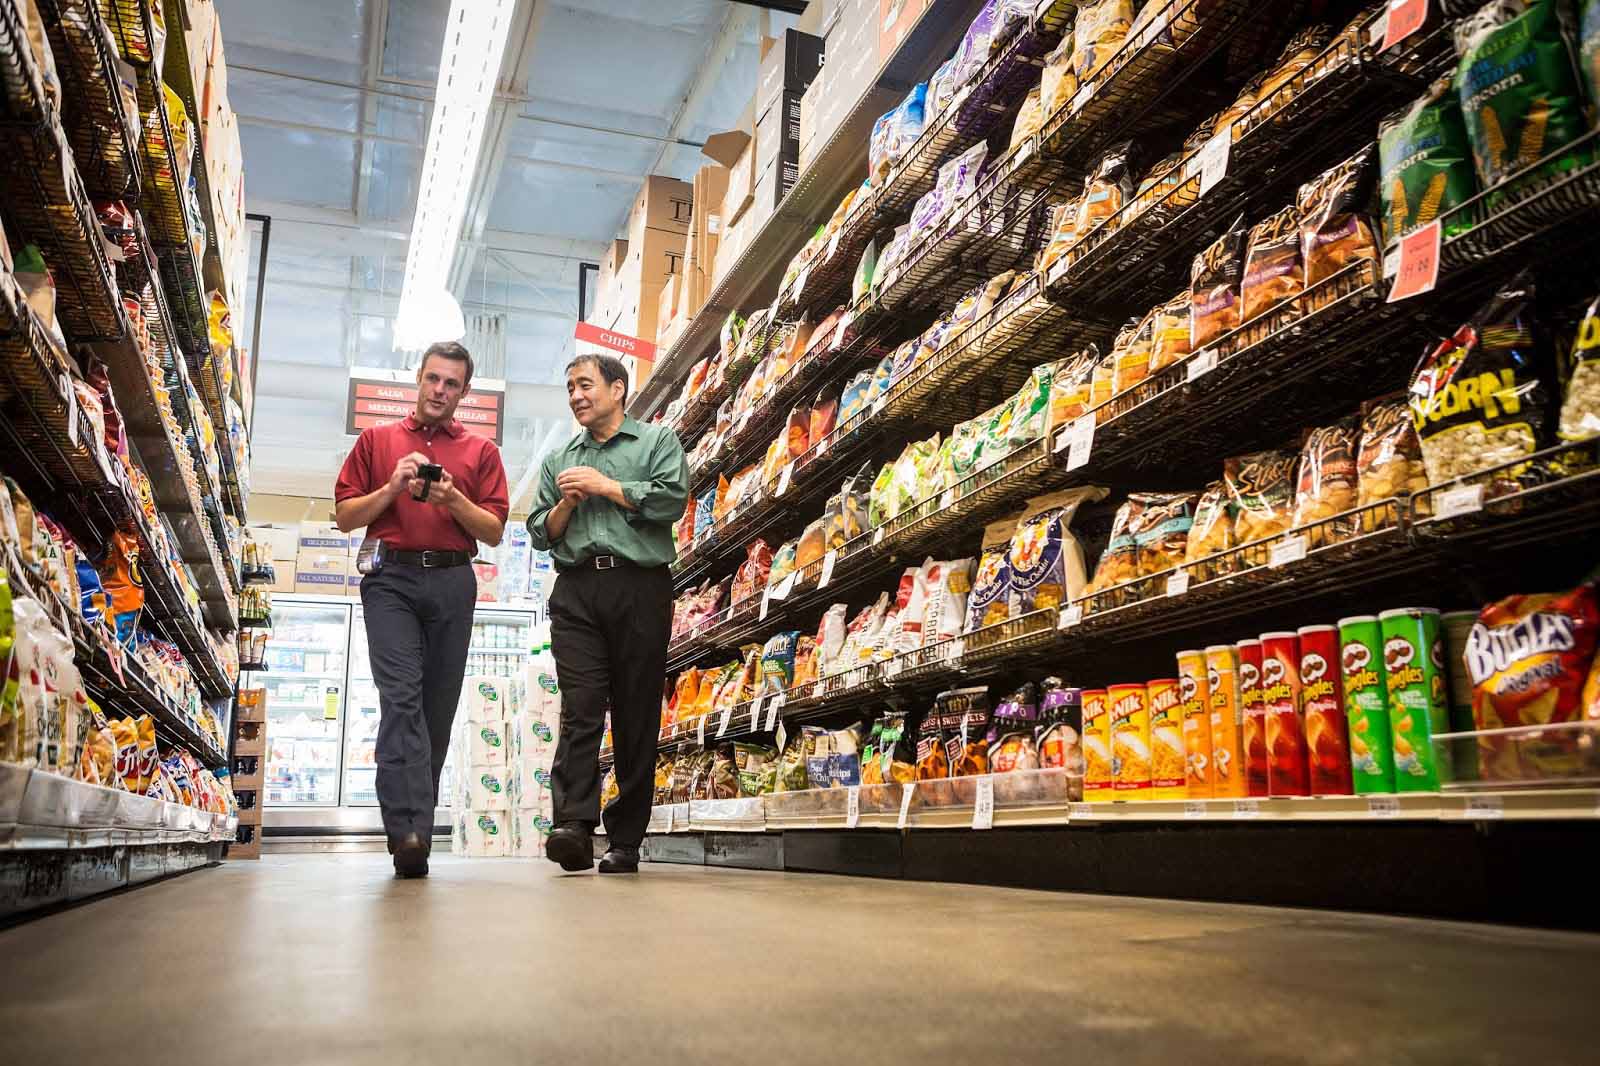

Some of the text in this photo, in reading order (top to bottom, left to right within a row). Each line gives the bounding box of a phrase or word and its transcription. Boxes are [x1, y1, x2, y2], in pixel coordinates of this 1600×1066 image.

[600, 332, 635, 351] CHIPS
[376, 388, 405, 400] SALSA
[368, 402, 410, 415] MEXICAN
[1463, 613, 1574, 688] BUGLES
